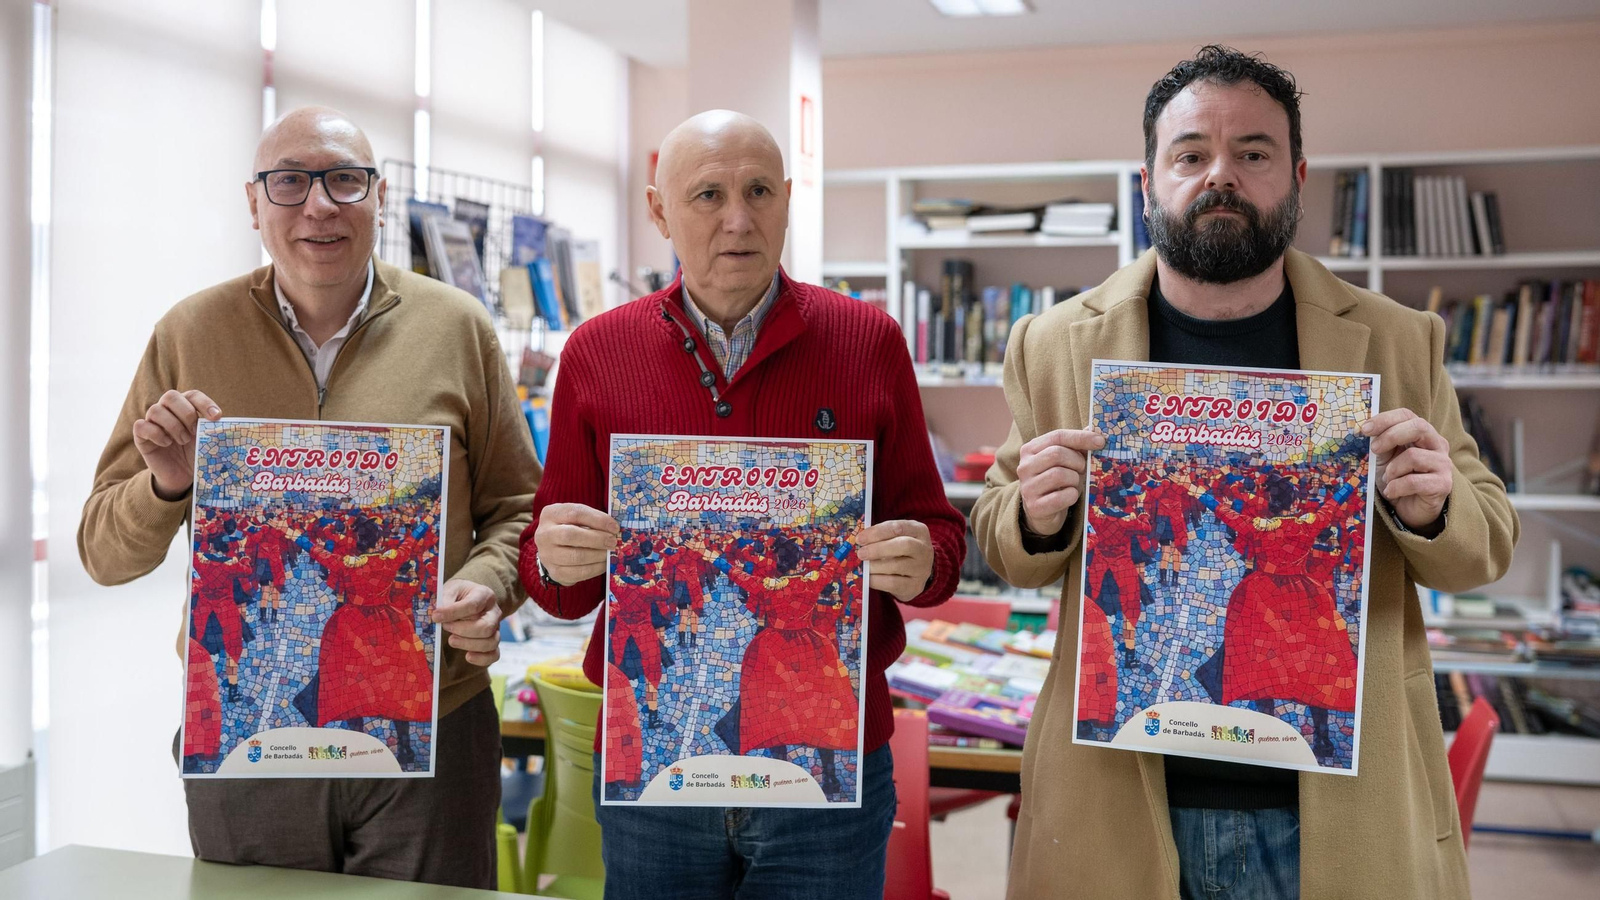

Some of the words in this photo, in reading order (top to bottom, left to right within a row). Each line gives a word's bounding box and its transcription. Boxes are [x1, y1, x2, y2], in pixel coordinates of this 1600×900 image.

[1144, 394, 1319, 424] ENTROIDO
[1150, 420, 1262, 449] Barbadás
[1267, 433, 1303, 447] 2026
[245, 447, 399, 470] ENTROIDO
[251, 471, 350, 494] Barbadás
[355, 479, 387, 491] 2026
[660, 464, 820, 489] ENTROIDO
[666, 490, 770, 514] Barbadás
[773, 499, 806, 510] 2026
[1168, 719, 1199, 728] Concello
[1172, 728, 1206, 738] Barbadás
